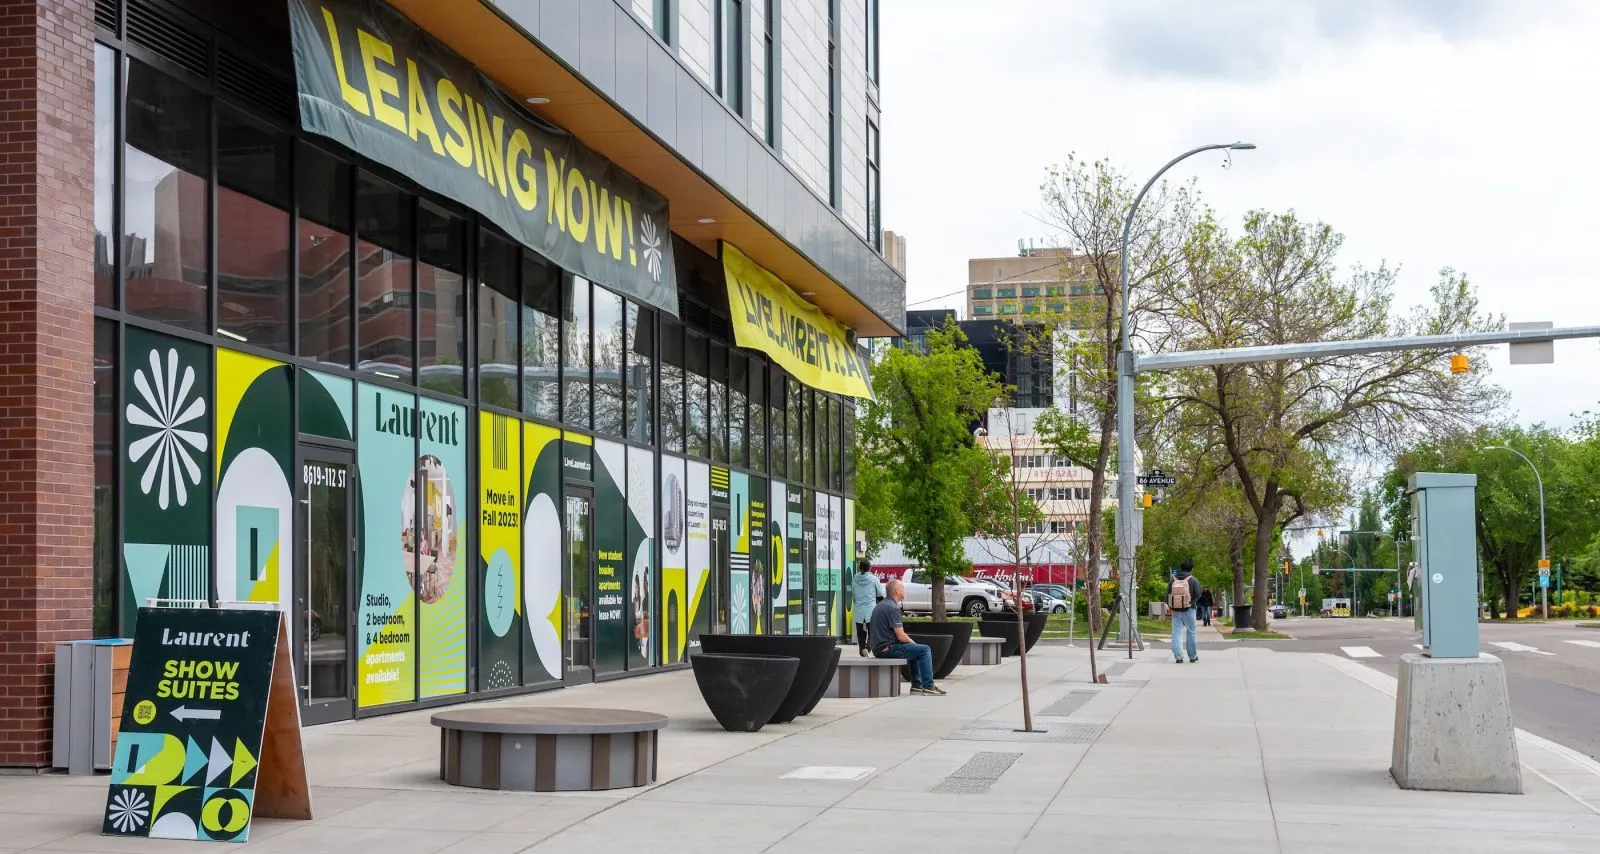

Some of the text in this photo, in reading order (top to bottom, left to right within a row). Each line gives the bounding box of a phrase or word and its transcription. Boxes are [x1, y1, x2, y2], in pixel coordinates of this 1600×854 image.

[321, 7, 637, 267] LEASING NOW!
[375, 391, 458, 447] Laurent
[303, 464, 347, 488] 8619-112 ST
[486, 488, 515, 507] Move in
[482, 510, 518, 528] Fall 2023!
[608, 550, 623, 560] student
[598, 564, 614, 577] housing
[974, 568, 1034, 582] Tim Hortns
[598, 580, 621, 592] apartments
[365, 593, 391, 609] Studio,
[598, 594, 616, 605] available
[366, 612, 405, 628] 2 bedroom,
[598, 609, 609, 620] lease
[161, 628, 251, 648] Laurent
[366, 630, 410, 645] & 4 bedroom
[365, 649, 405, 665] apartments
[163, 659, 240, 680] SHOW
[365, 667, 399, 684] available!
[157, 679, 240, 701] SUITES
